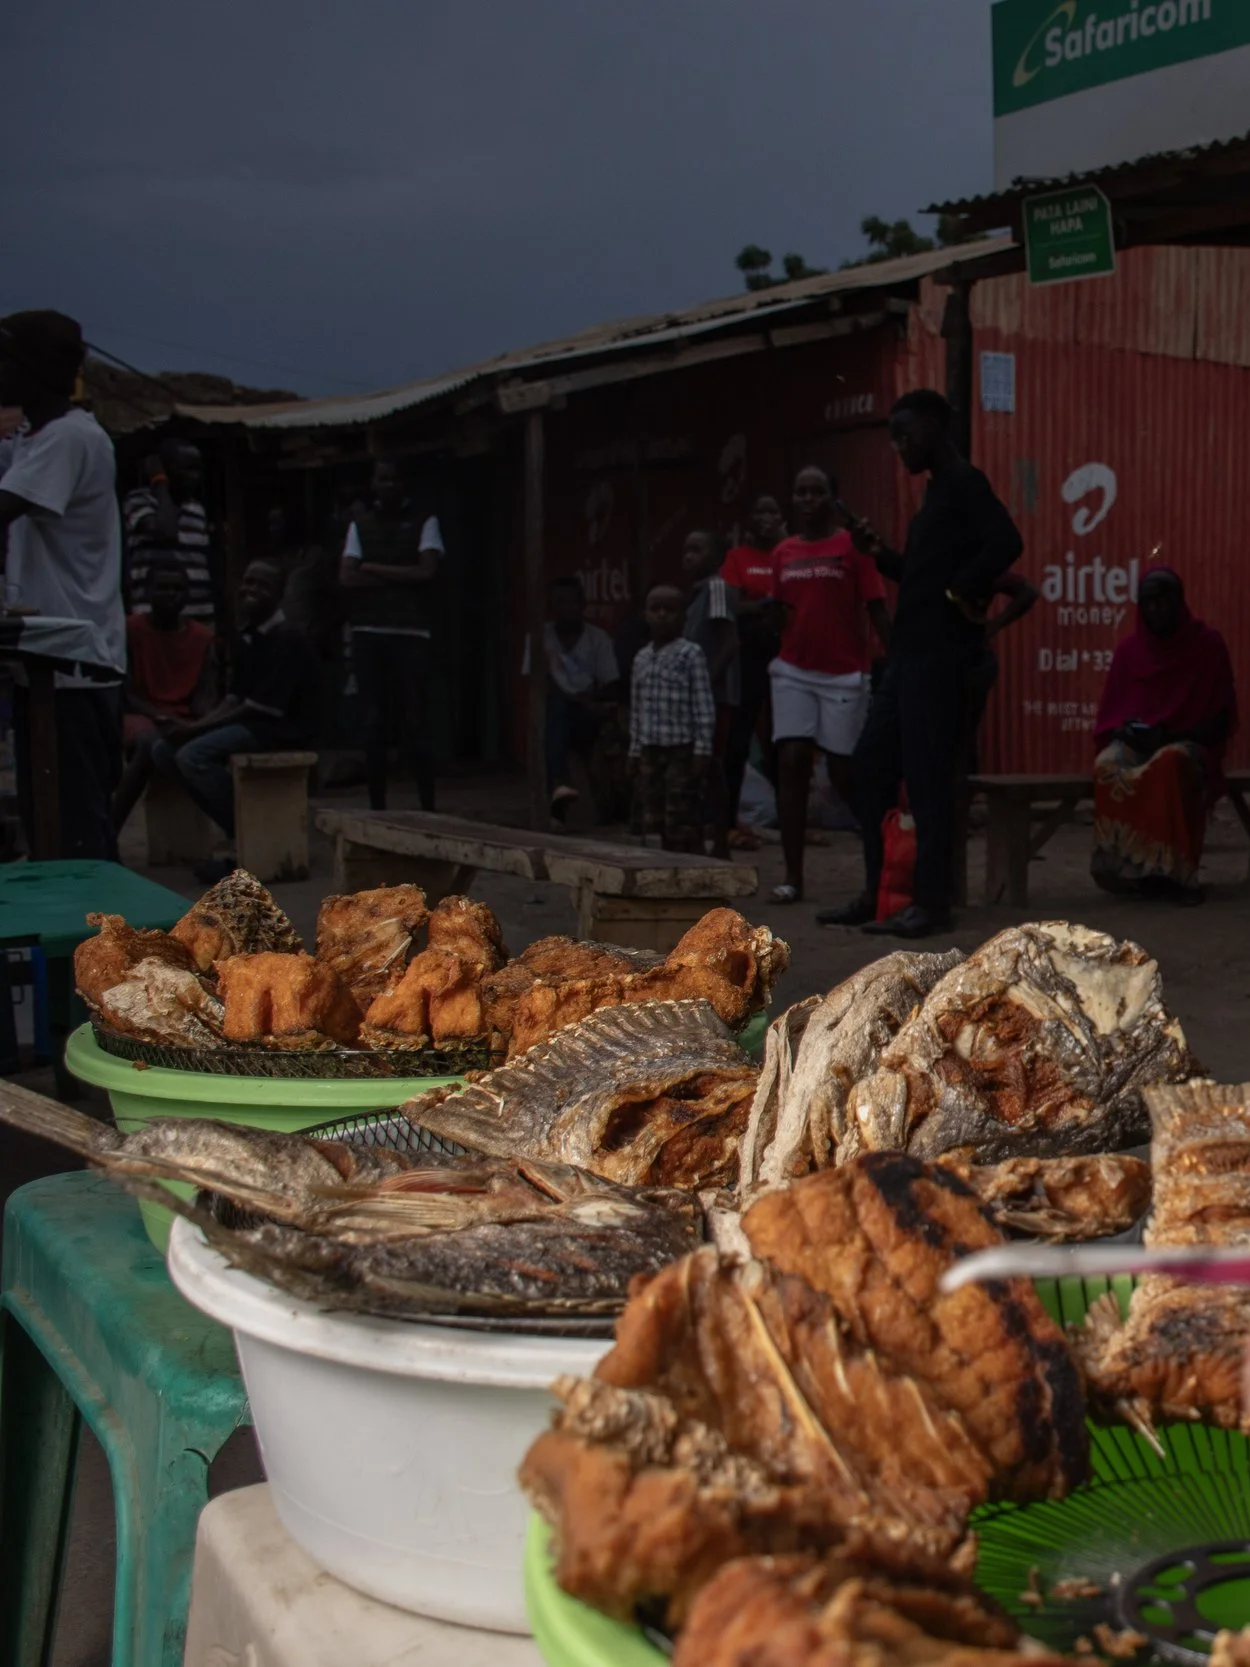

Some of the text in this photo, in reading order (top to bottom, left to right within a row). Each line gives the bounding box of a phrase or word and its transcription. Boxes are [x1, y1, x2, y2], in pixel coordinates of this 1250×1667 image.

[1044, 0, 1211, 66] Safaricom
[1042, 550, 1140, 604] airtel
[1057, 605, 1126, 629] money
[1038, 648, 1078, 672] Dial
